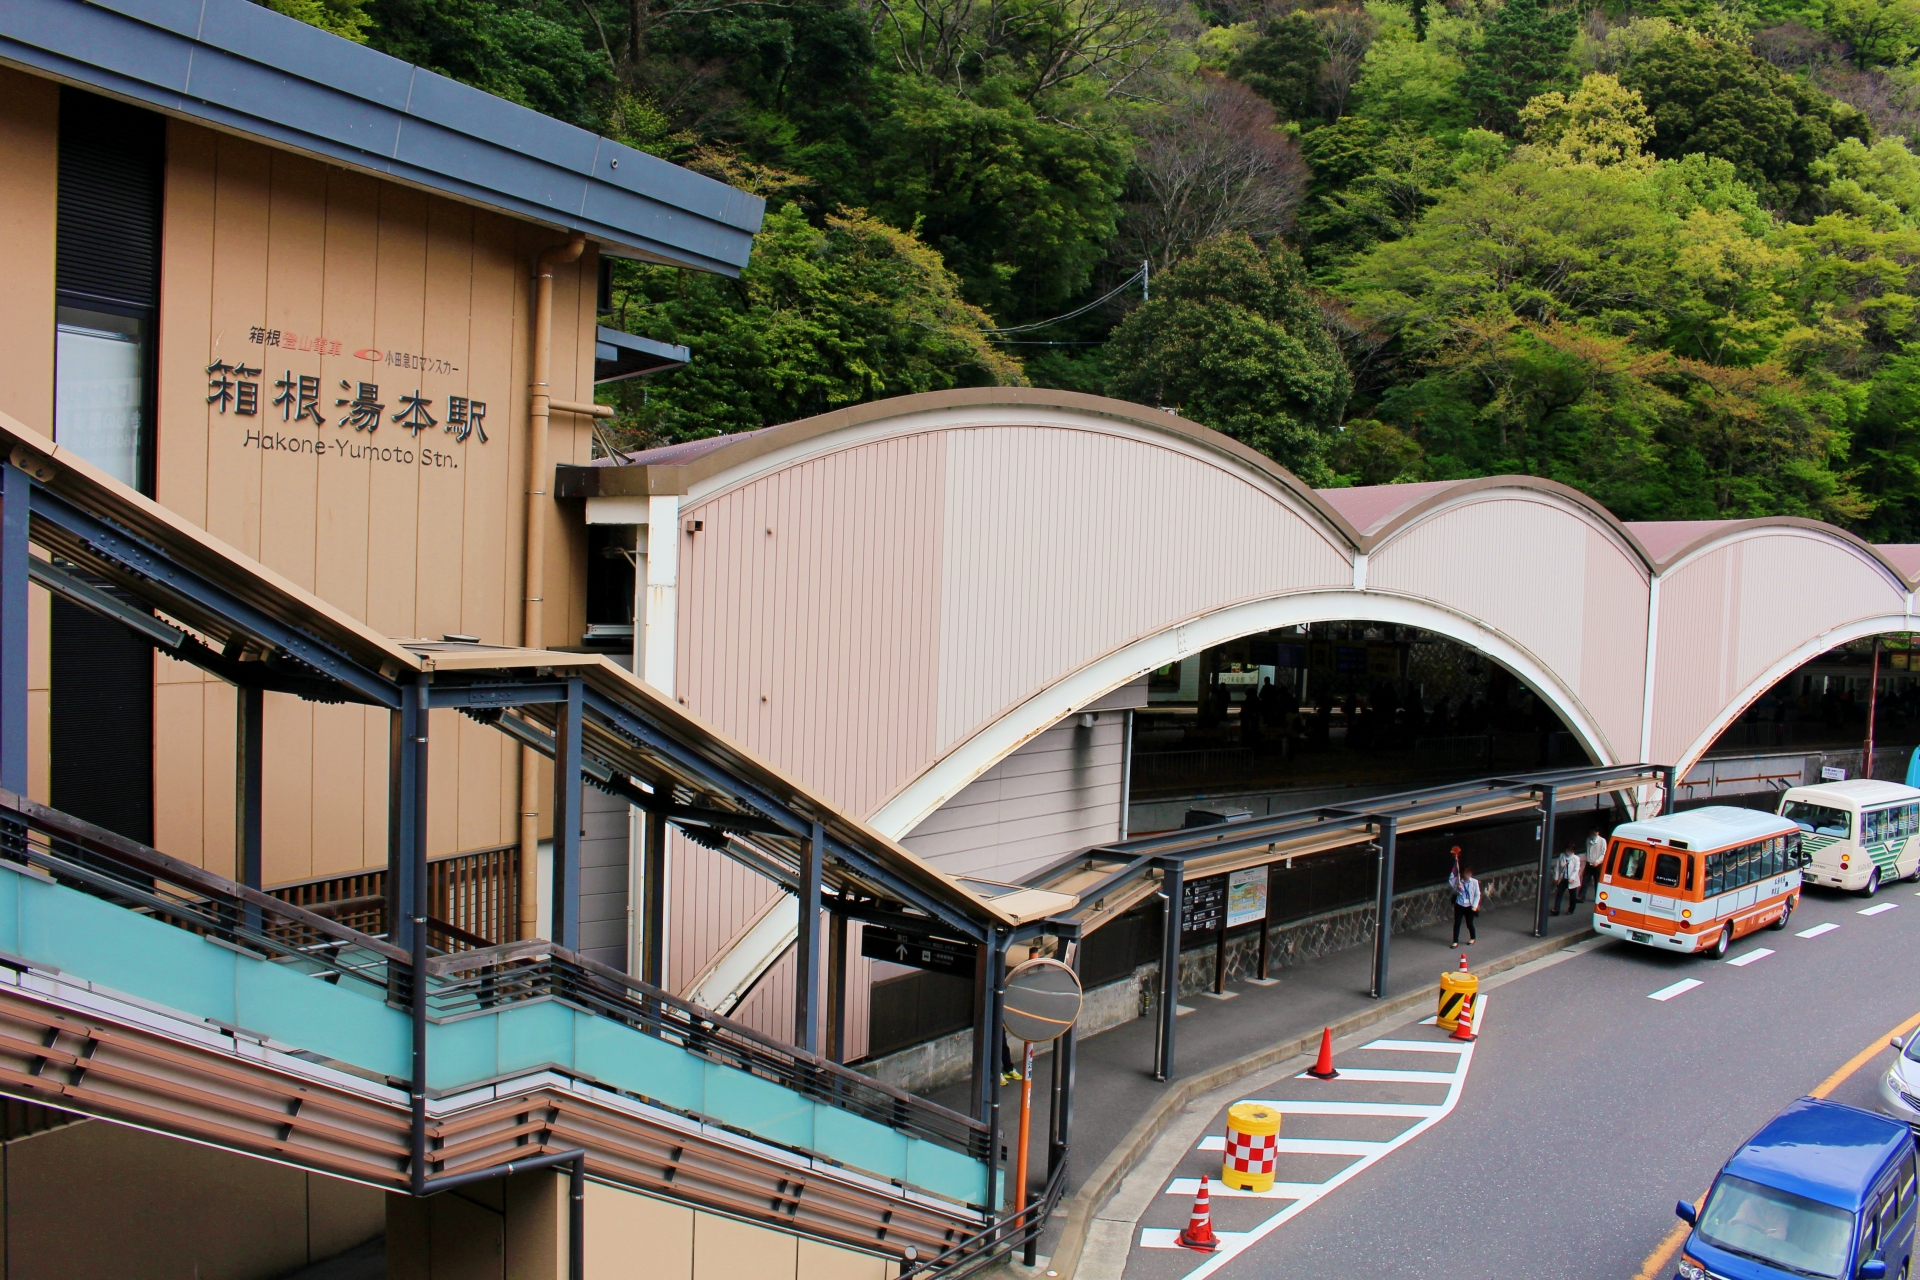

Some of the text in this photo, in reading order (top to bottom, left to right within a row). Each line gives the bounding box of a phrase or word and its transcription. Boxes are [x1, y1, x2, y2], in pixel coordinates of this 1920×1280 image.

[248, 325, 343, 357] 箱根登山電車
[385, 350, 459, 375] 小田急ロマンスカー
[205, 358, 489, 444] 箱根湯本駅
[243, 428, 458, 469] Hakone-Yumoto Stn.
